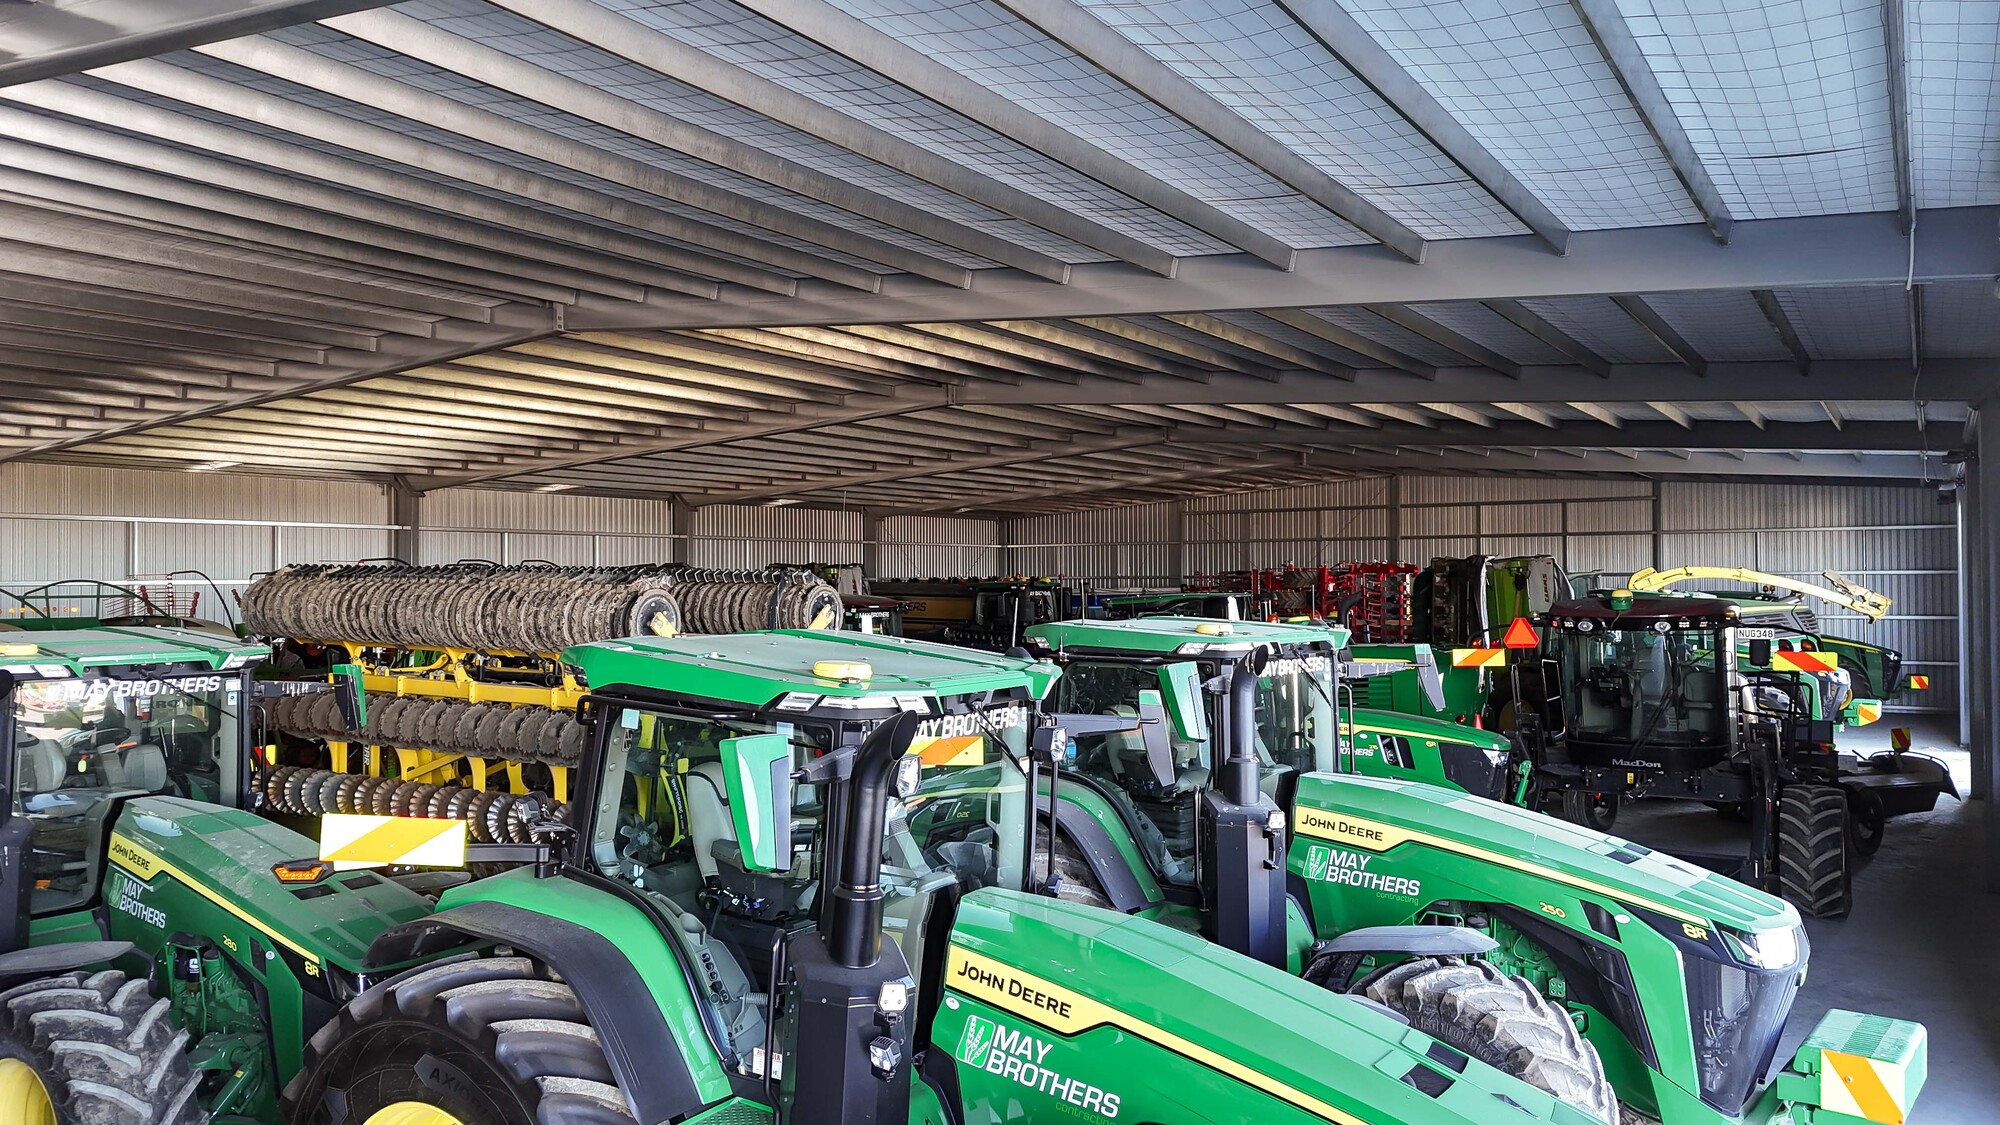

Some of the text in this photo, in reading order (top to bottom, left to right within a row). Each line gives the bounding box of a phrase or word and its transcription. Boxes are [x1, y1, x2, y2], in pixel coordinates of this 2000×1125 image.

[1739, 629, 1774, 638] NUG348
[1262, 660, 1280, 678] AY
[116, 676, 221, 698] BROTHERS
[914, 706, 1019, 742] AY BROTHERS
[1340, 747, 1375, 757] OTHERS
[1612, 758, 1662, 768] MacDon
[1301, 814, 1383, 842] JOHN DEERE
[112, 841, 151, 871] JOHN DEERE
[1328, 848, 1372, 871] MAY
[122, 877, 144, 900] MAY
[1325, 866, 1421, 897] BROTHERS
[1375, 891, 1420, 906] contracting
[118, 894, 167, 929] BROTHERS
[1539, 901, 1567, 919] 250
[1681, 922, 1709, 941] 8R
[222, 935, 238, 952] 280
[304, 960, 320, 978] 8R
[957, 960, 1072, 1019] JOHN DEERE
[993, 1024, 1054, 1065] MAY
[985, 1048, 1121, 1118] BROTHERS
